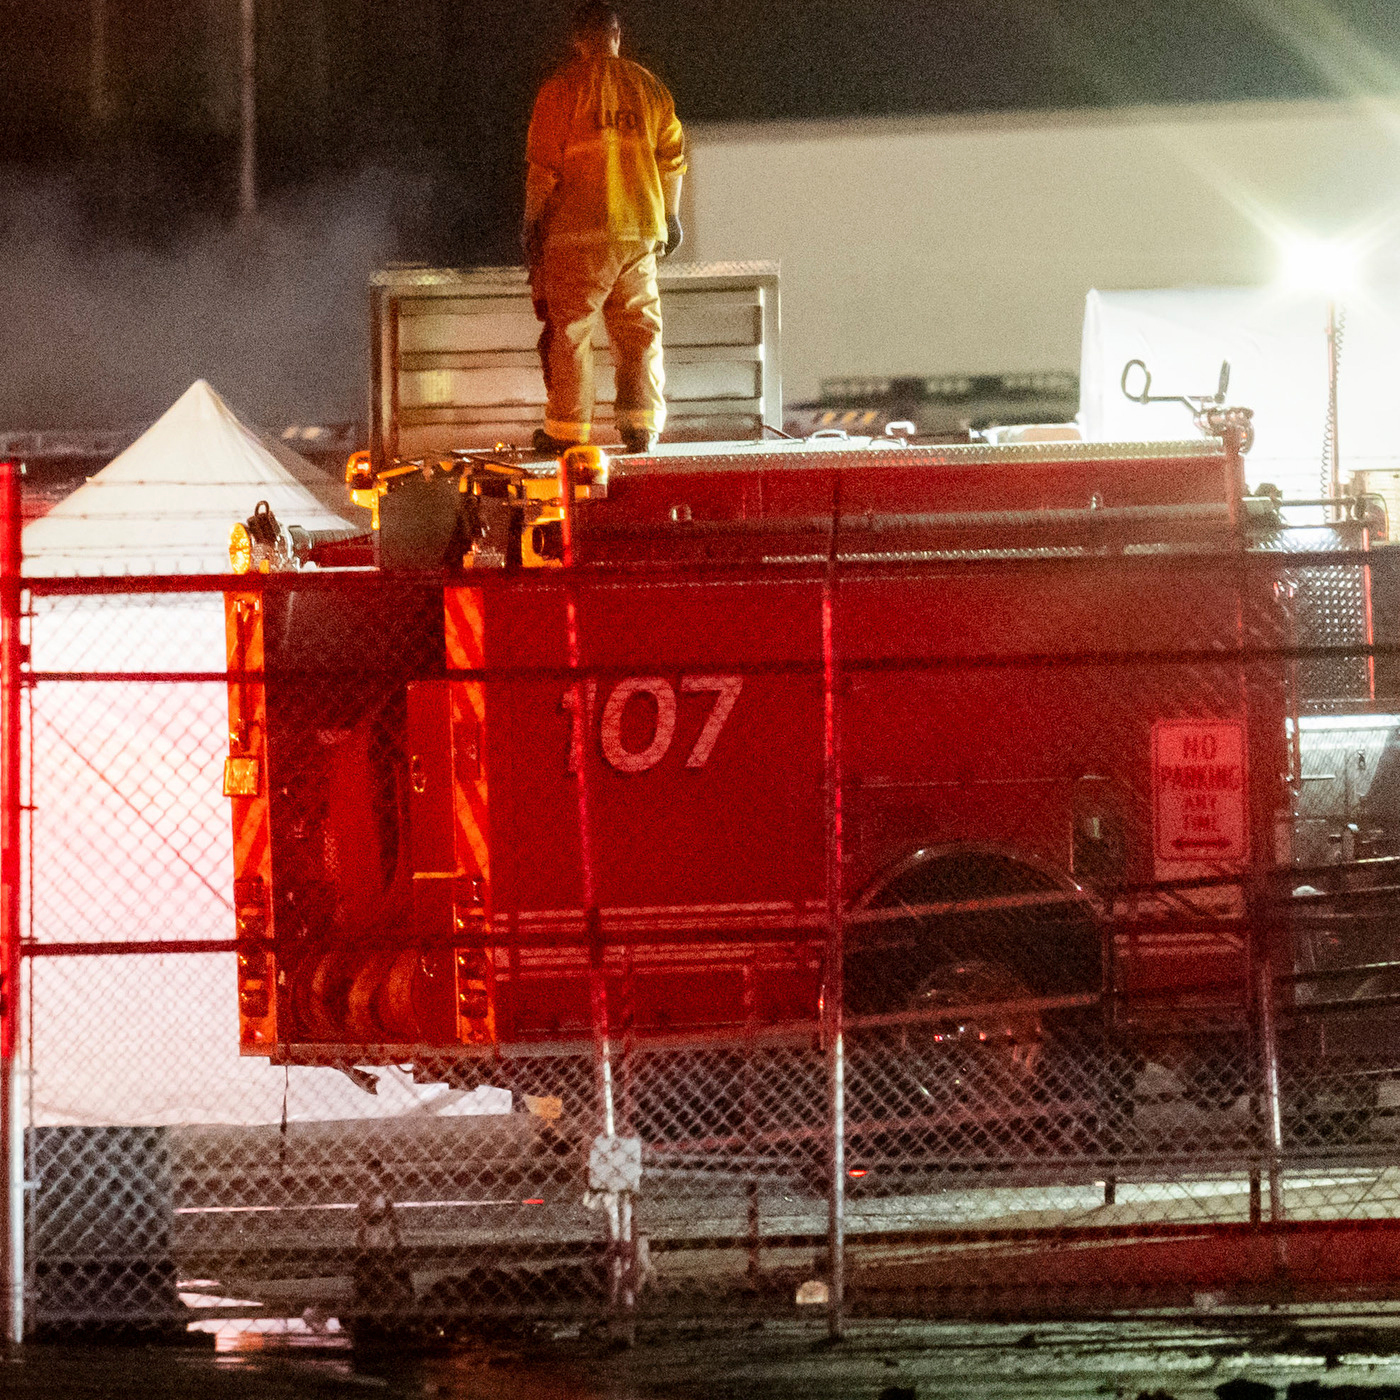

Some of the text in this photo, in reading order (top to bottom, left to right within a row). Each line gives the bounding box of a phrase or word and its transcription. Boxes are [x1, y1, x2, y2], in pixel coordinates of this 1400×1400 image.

[561, 675, 744, 773] 107
[1182, 734, 1218, 760] NO
[1159, 764, 1241, 791] PARKING
[1183, 794, 1219, 812] ANY
